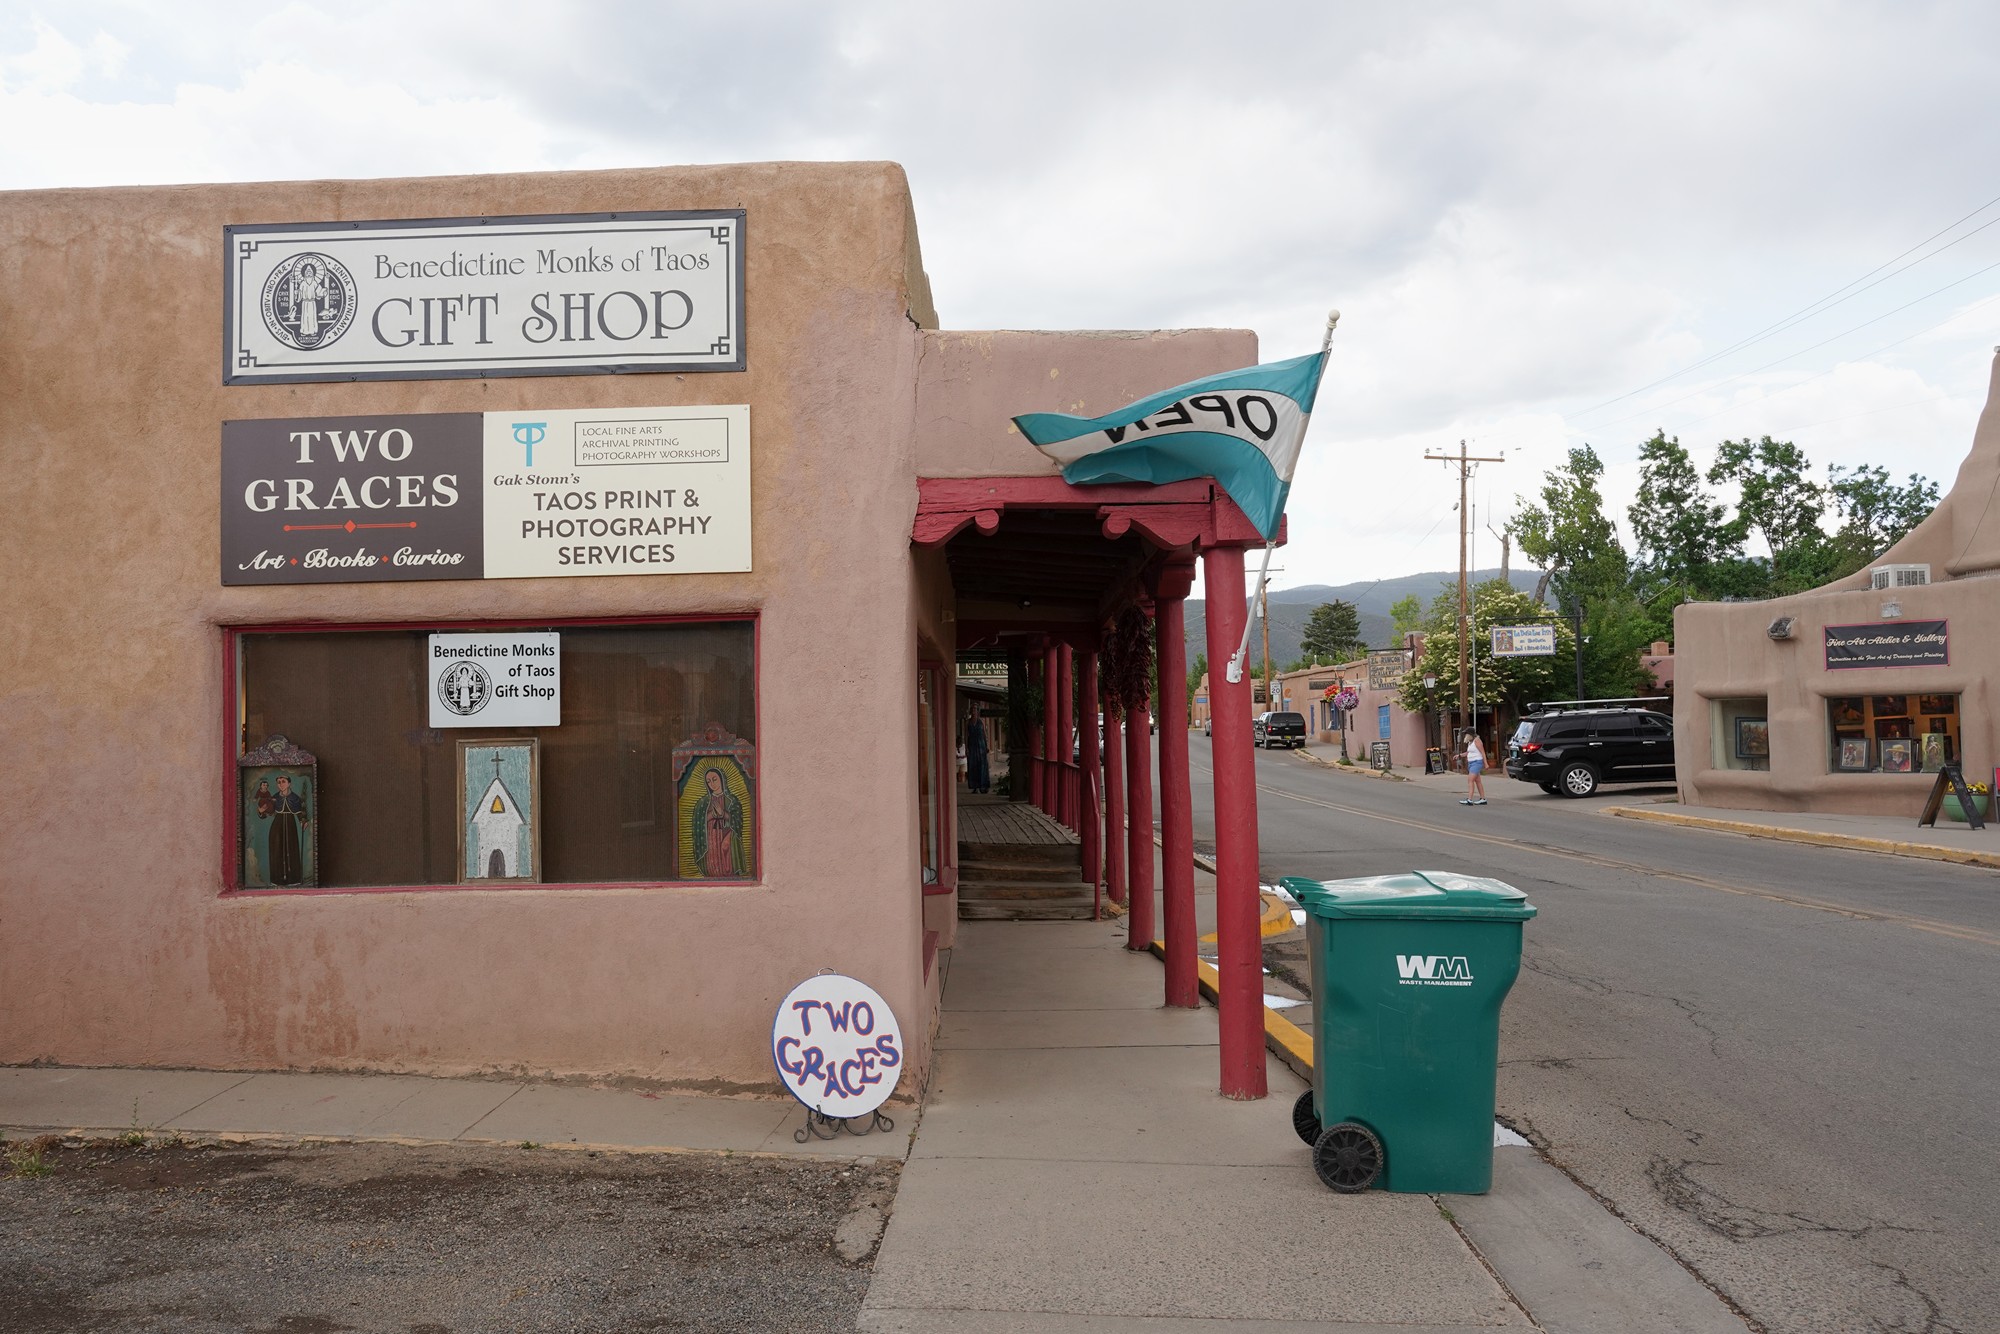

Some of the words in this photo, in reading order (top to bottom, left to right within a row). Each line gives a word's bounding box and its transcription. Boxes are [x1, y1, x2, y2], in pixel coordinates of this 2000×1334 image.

[375, 250, 525, 280] Benedictine
[536, 245, 614, 274] Monks
[621, 248, 642, 271] of
[650, 245, 710, 271] Taos
[371, 293, 498, 349] GIFT
[521, 289, 694, 343] SHOP
[582, 427, 613, 436] LOCAL
[615, 427, 637, 435] FINE
[639, 426, 663, 435] ARTS
[289, 428, 413, 463] TWO
[582, 439, 630, 448] ARCHIVAL
[632, 438, 679, 447] PRINTING
[582, 451, 657, 461] PHOTOGRAPHY
[659, 449, 721, 459] WORKSHOPS
[493, 474, 523, 487] Gak
[525, 473, 580, 486] Stonn's
[244, 474, 459, 512] GRACES
[533, 491, 597, 511] TAOS
[605, 489, 676, 509] PRINT
[683, 489, 700, 508] &
[522, 515, 712, 538] PHOTOGRAPHY
[238, 550, 286, 571] Art
[303, 547, 379, 569] Books
[392, 546, 465, 567] Curios
[558, 544, 675, 565] SERVICES
[434, 644, 508, 658] Benedictine
[512, 643, 555, 657] Monks
[1826, 638, 1845, 646] Fine
[1846, 637, 1866, 645] Art
[1867, 635, 1900, 645] Atelier
[1901, 634, 1911, 643] &
[1914, 633, 1947, 645] Gallery
[508, 664, 522, 677] of
[525, 664, 555, 677] Taos
[495, 685, 519, 698] Gift
[522, 684, 555, 700] Shop
[1396, 955, 1471, 980] WM
[792, 999, 875, 1036] TWO
[776, 1033, 900, 1099] GRACES
